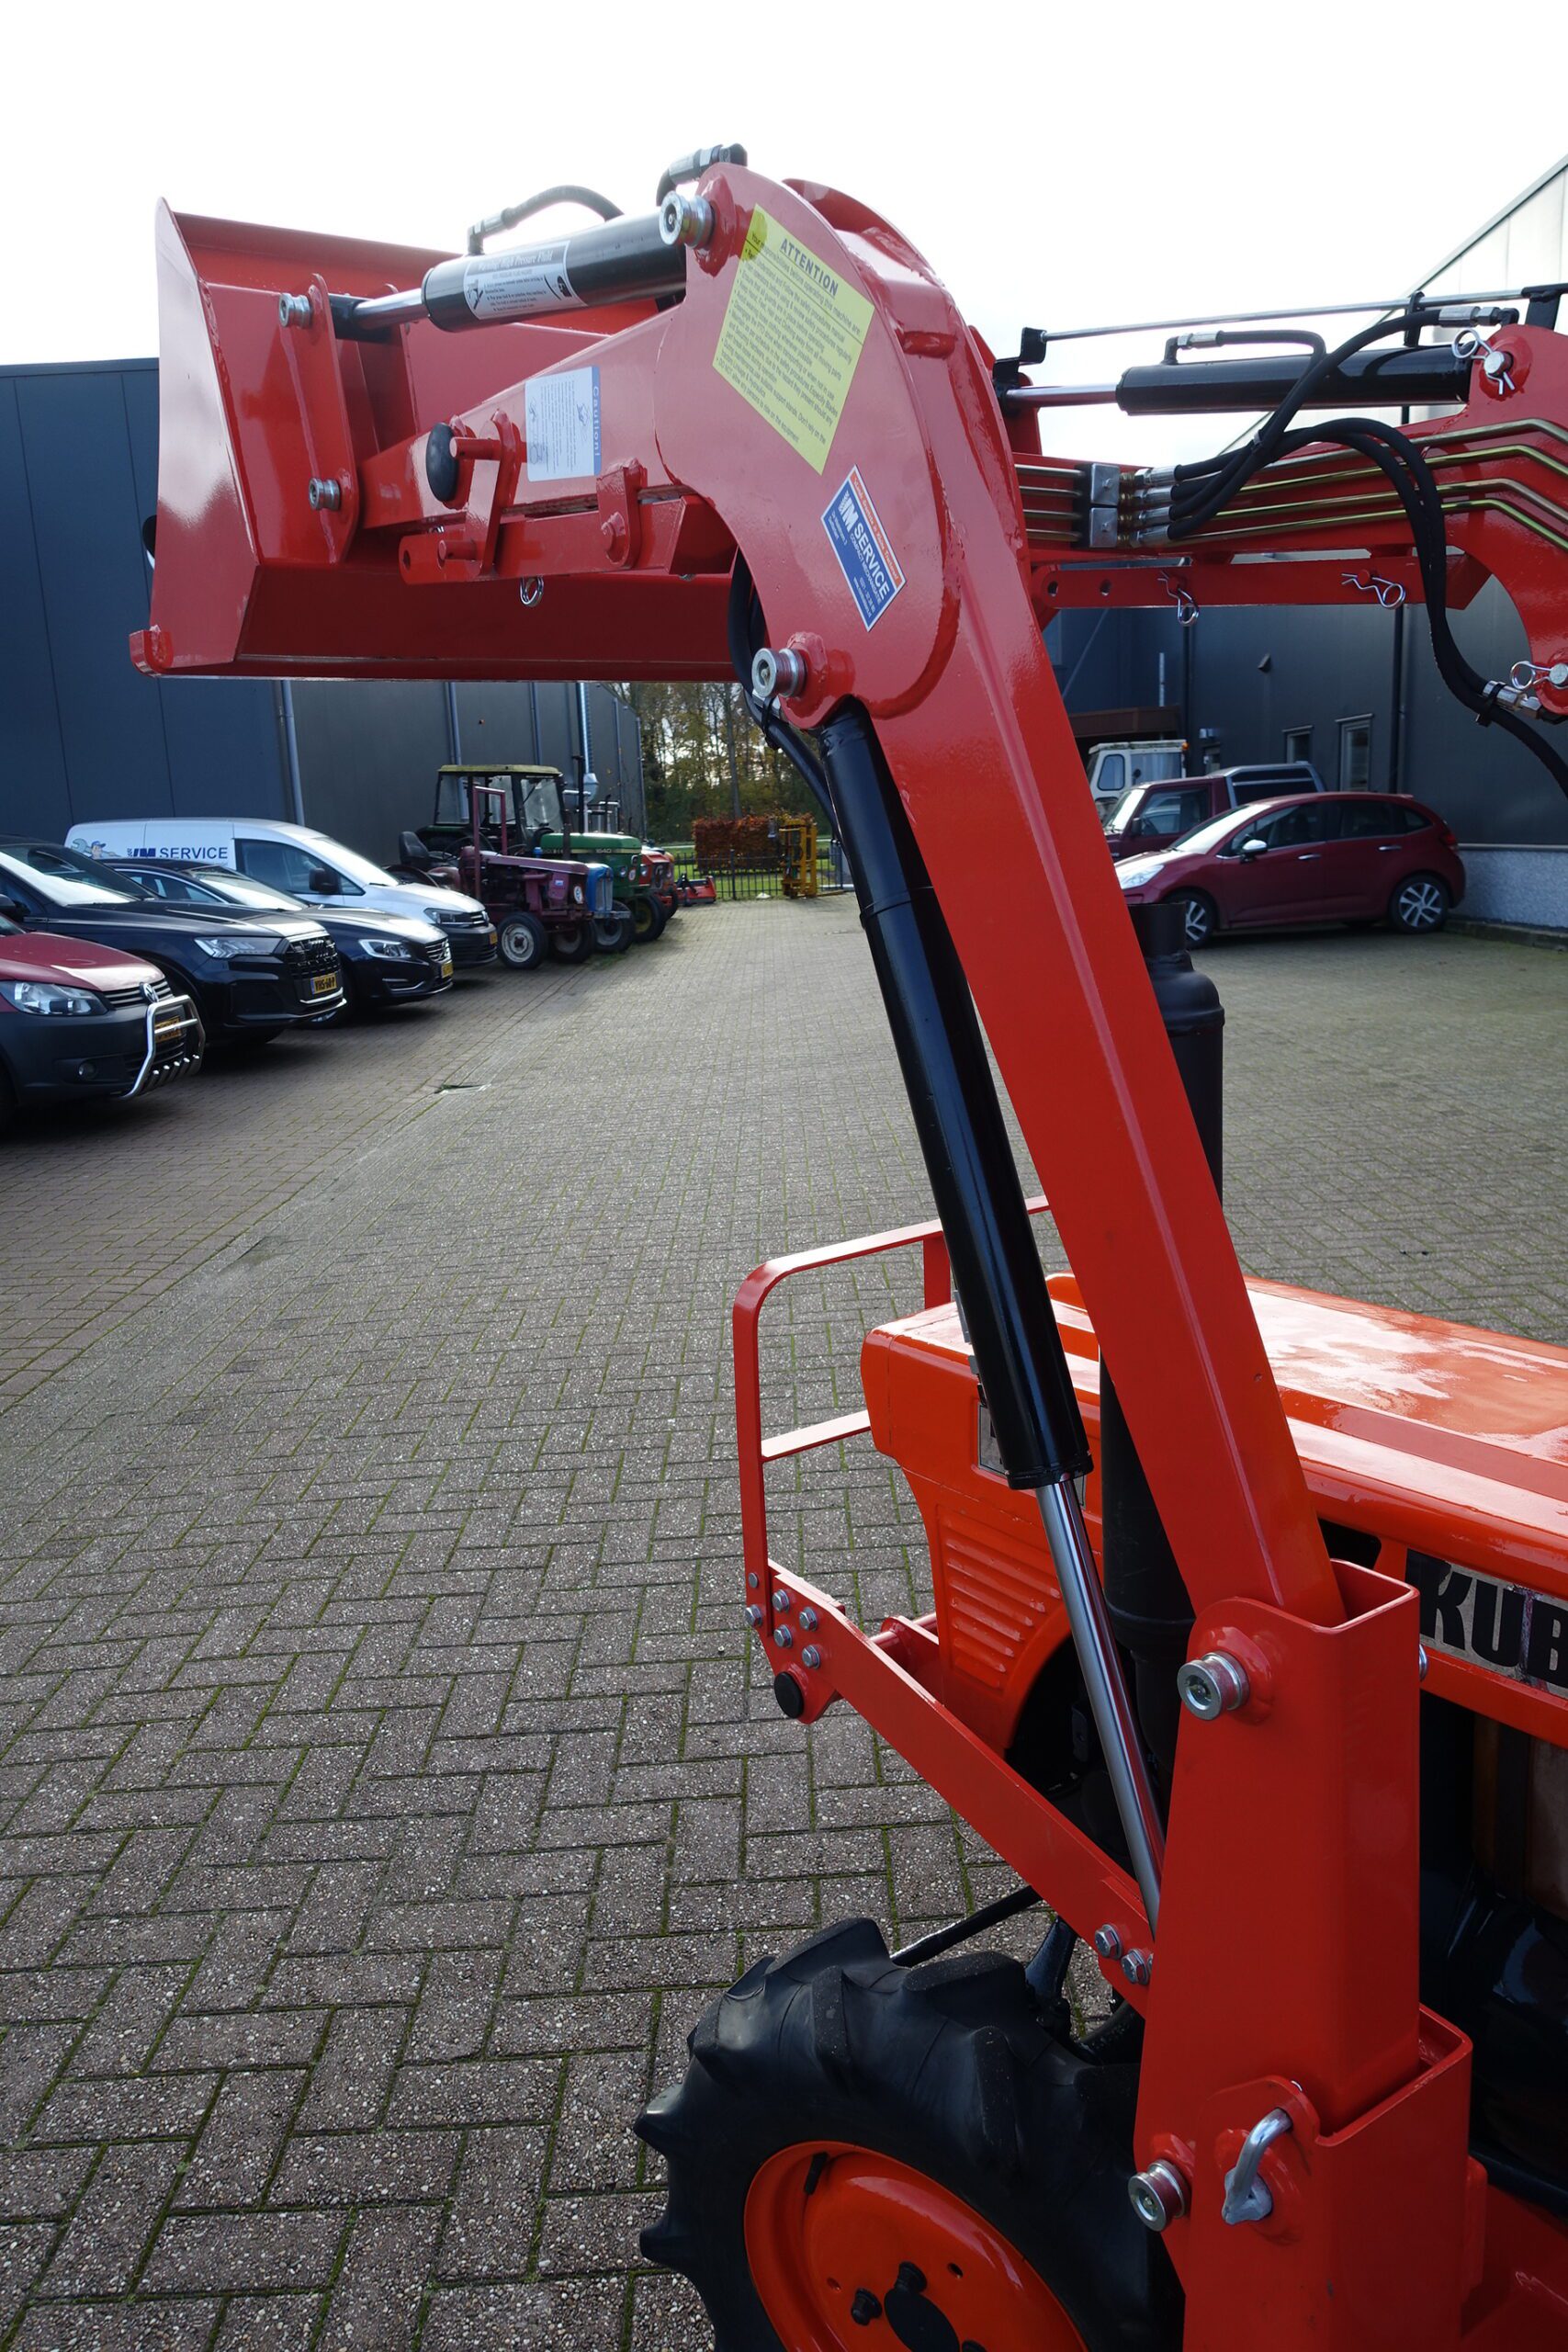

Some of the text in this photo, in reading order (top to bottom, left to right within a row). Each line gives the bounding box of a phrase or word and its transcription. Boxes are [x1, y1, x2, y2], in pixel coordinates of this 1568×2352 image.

[780, 235, 839, 297] ATTENTION
[832, 306, 852, 328] machine
[592, 385, 601, 457] Caution!
[849, 532, 863, 563] COMPACT
[852, 520, 890, 600] SERVICE
[160, 847, 228, 859] SERVICE
[1420, 1562, 1568, 1690] KUB
